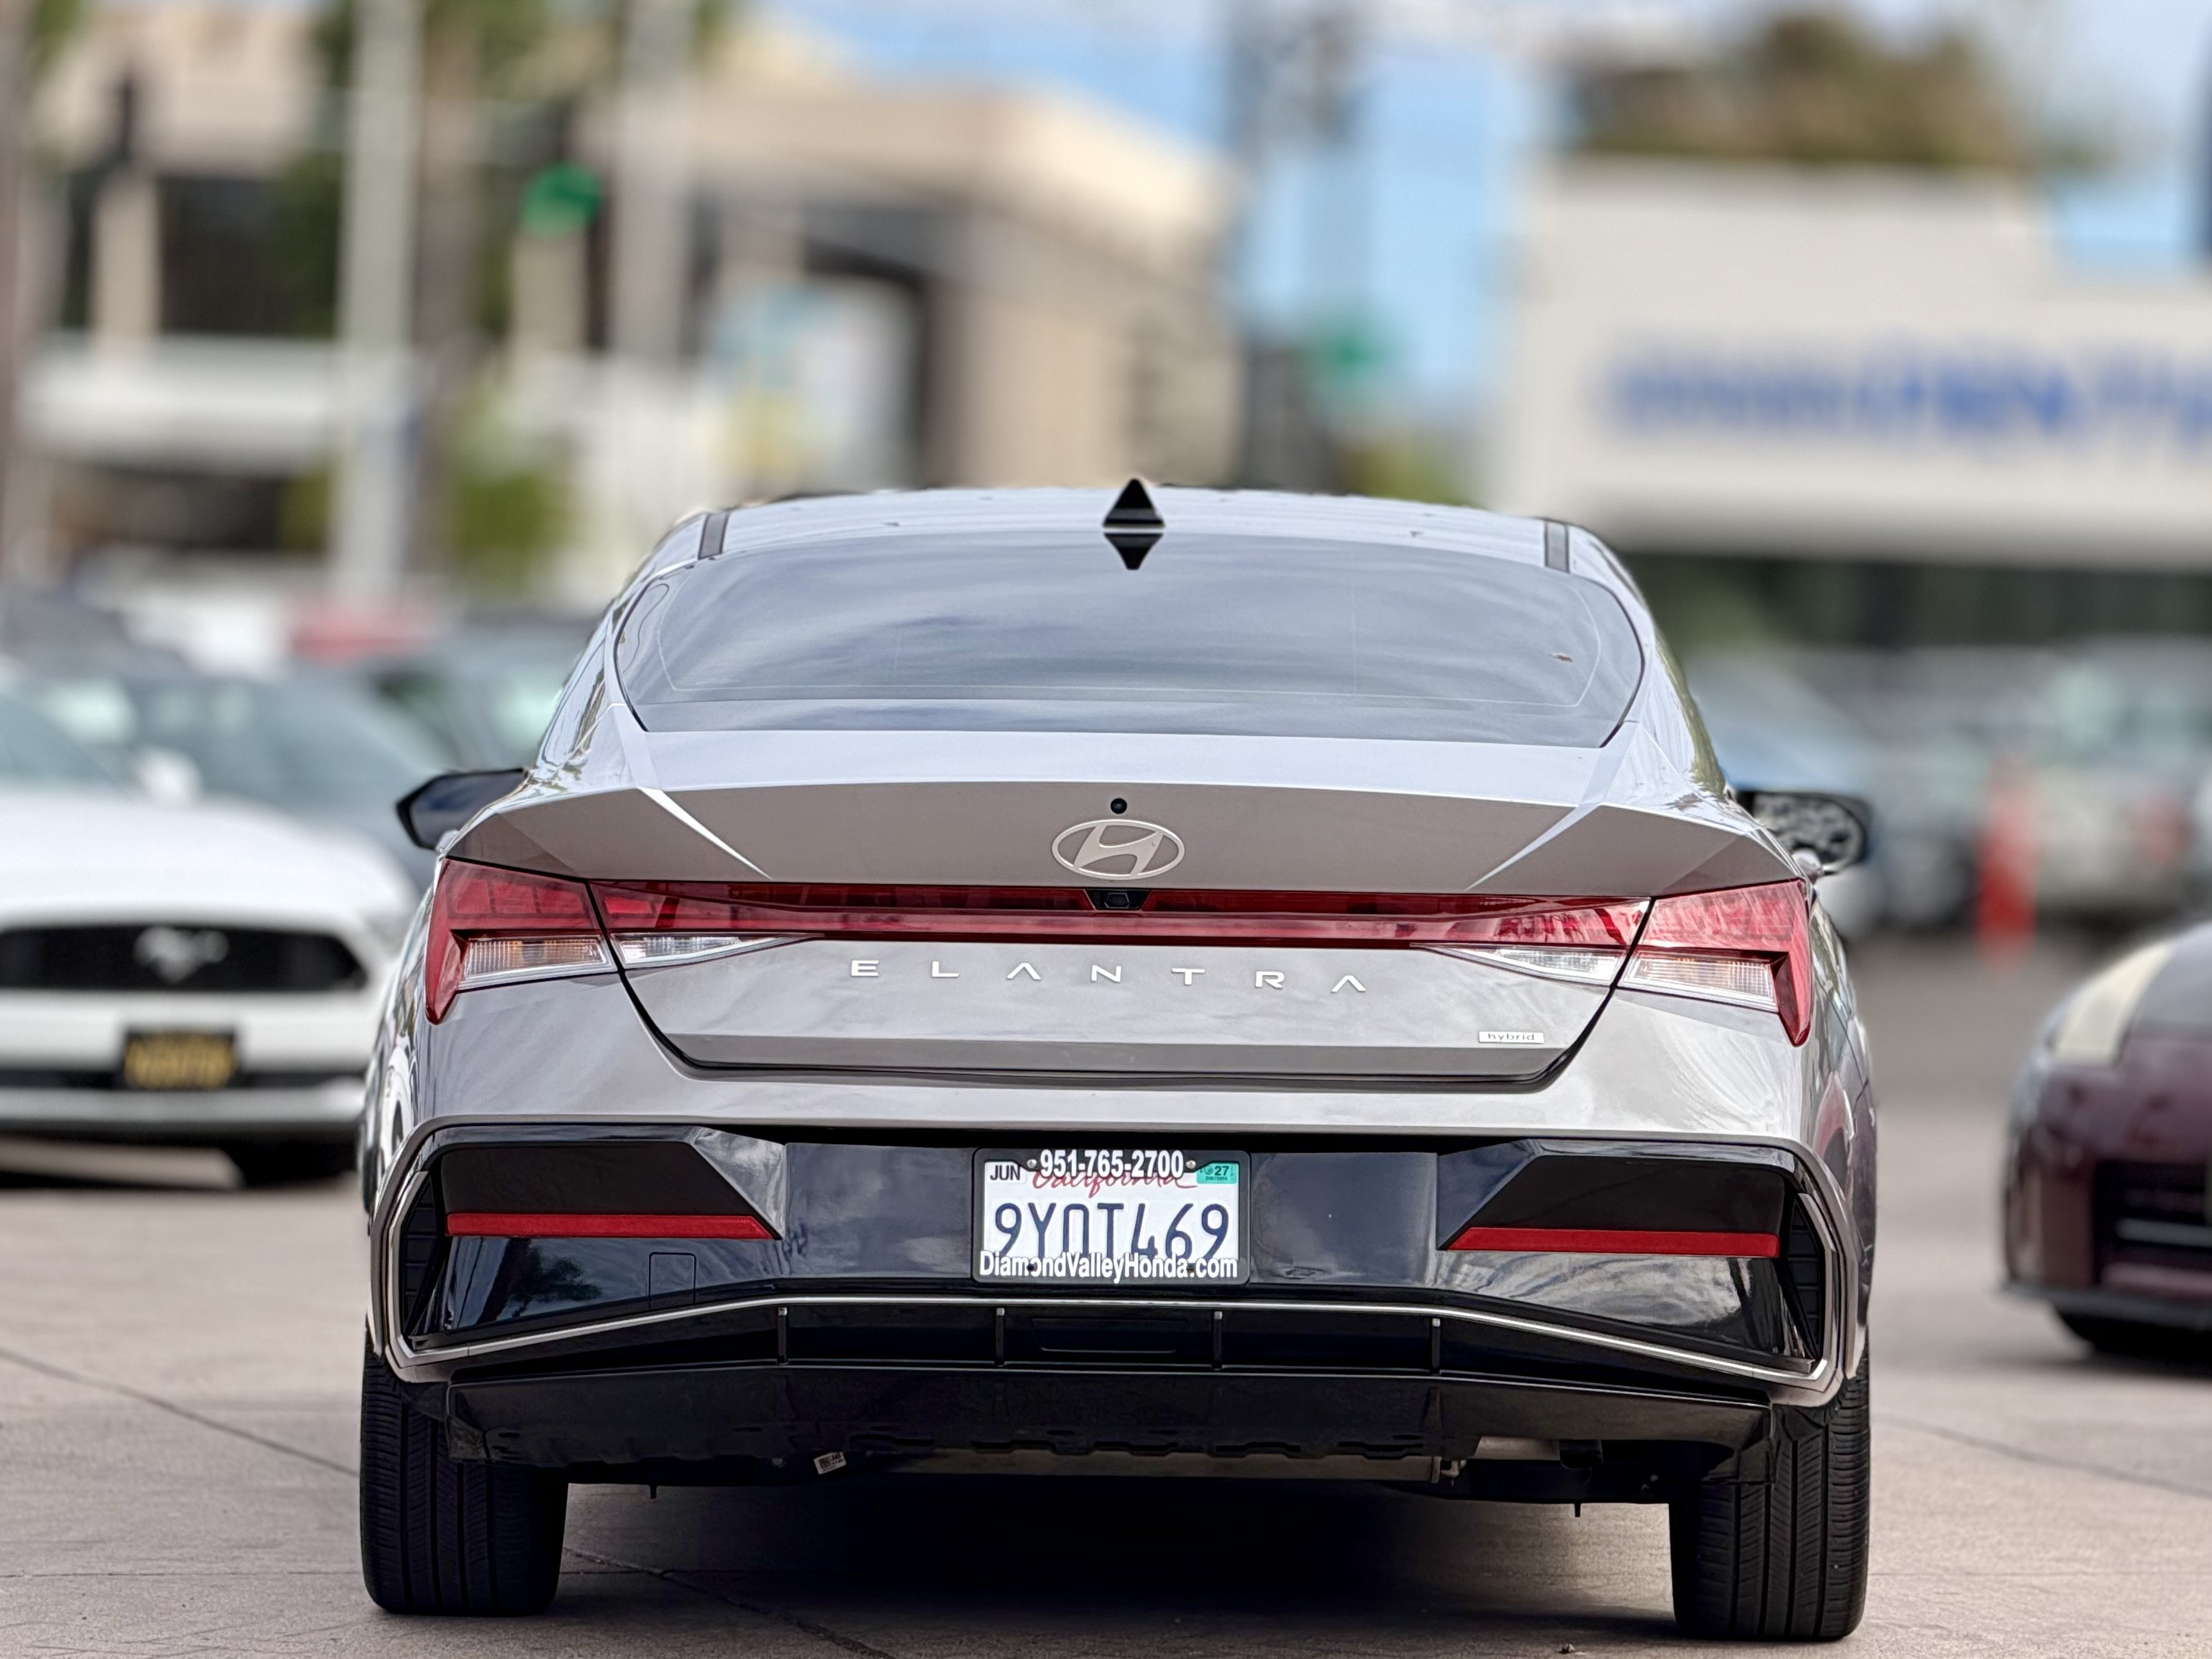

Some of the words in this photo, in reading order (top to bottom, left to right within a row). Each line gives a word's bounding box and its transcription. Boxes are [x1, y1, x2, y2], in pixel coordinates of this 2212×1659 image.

[851, 960, 1366, 992] ELANTRA
[1488, 1032, 1534, 1041] hybrid
[990, 1165, 1020, 1181] JUN
[1040, 1149, 1183, 1178] 951-765-2700
[1214, 1165, 1229, 1176] 27
[980, 1251, 1238, 1284] DiamondValleyHonda.com
